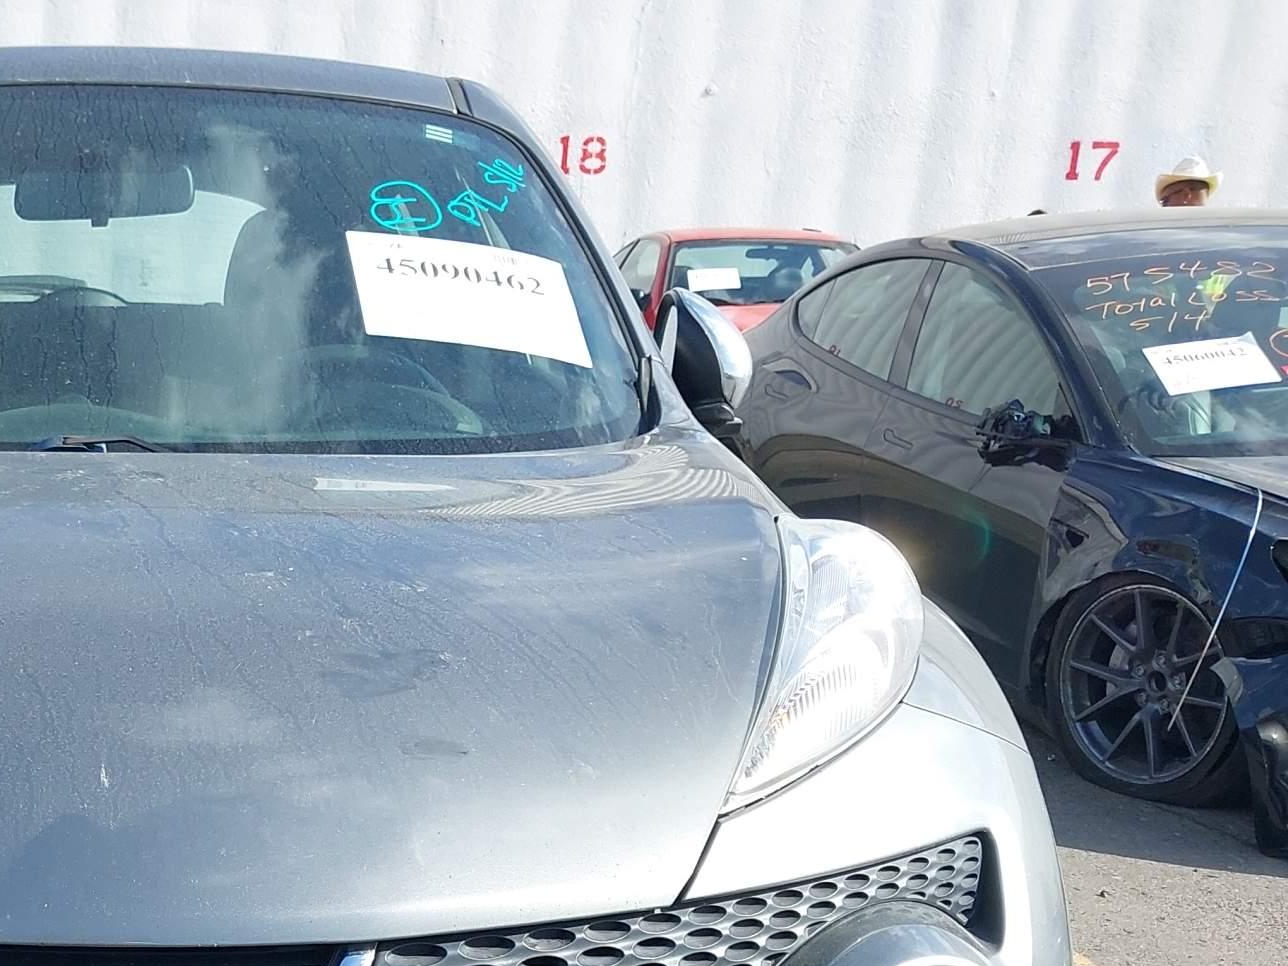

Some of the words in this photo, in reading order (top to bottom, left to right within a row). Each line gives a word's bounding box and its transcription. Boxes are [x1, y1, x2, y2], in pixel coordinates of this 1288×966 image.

[560, 136, 607, 175] 18
[1065, 141, 1120, 181] 17
[376, 257, 545, 296] 45090462
